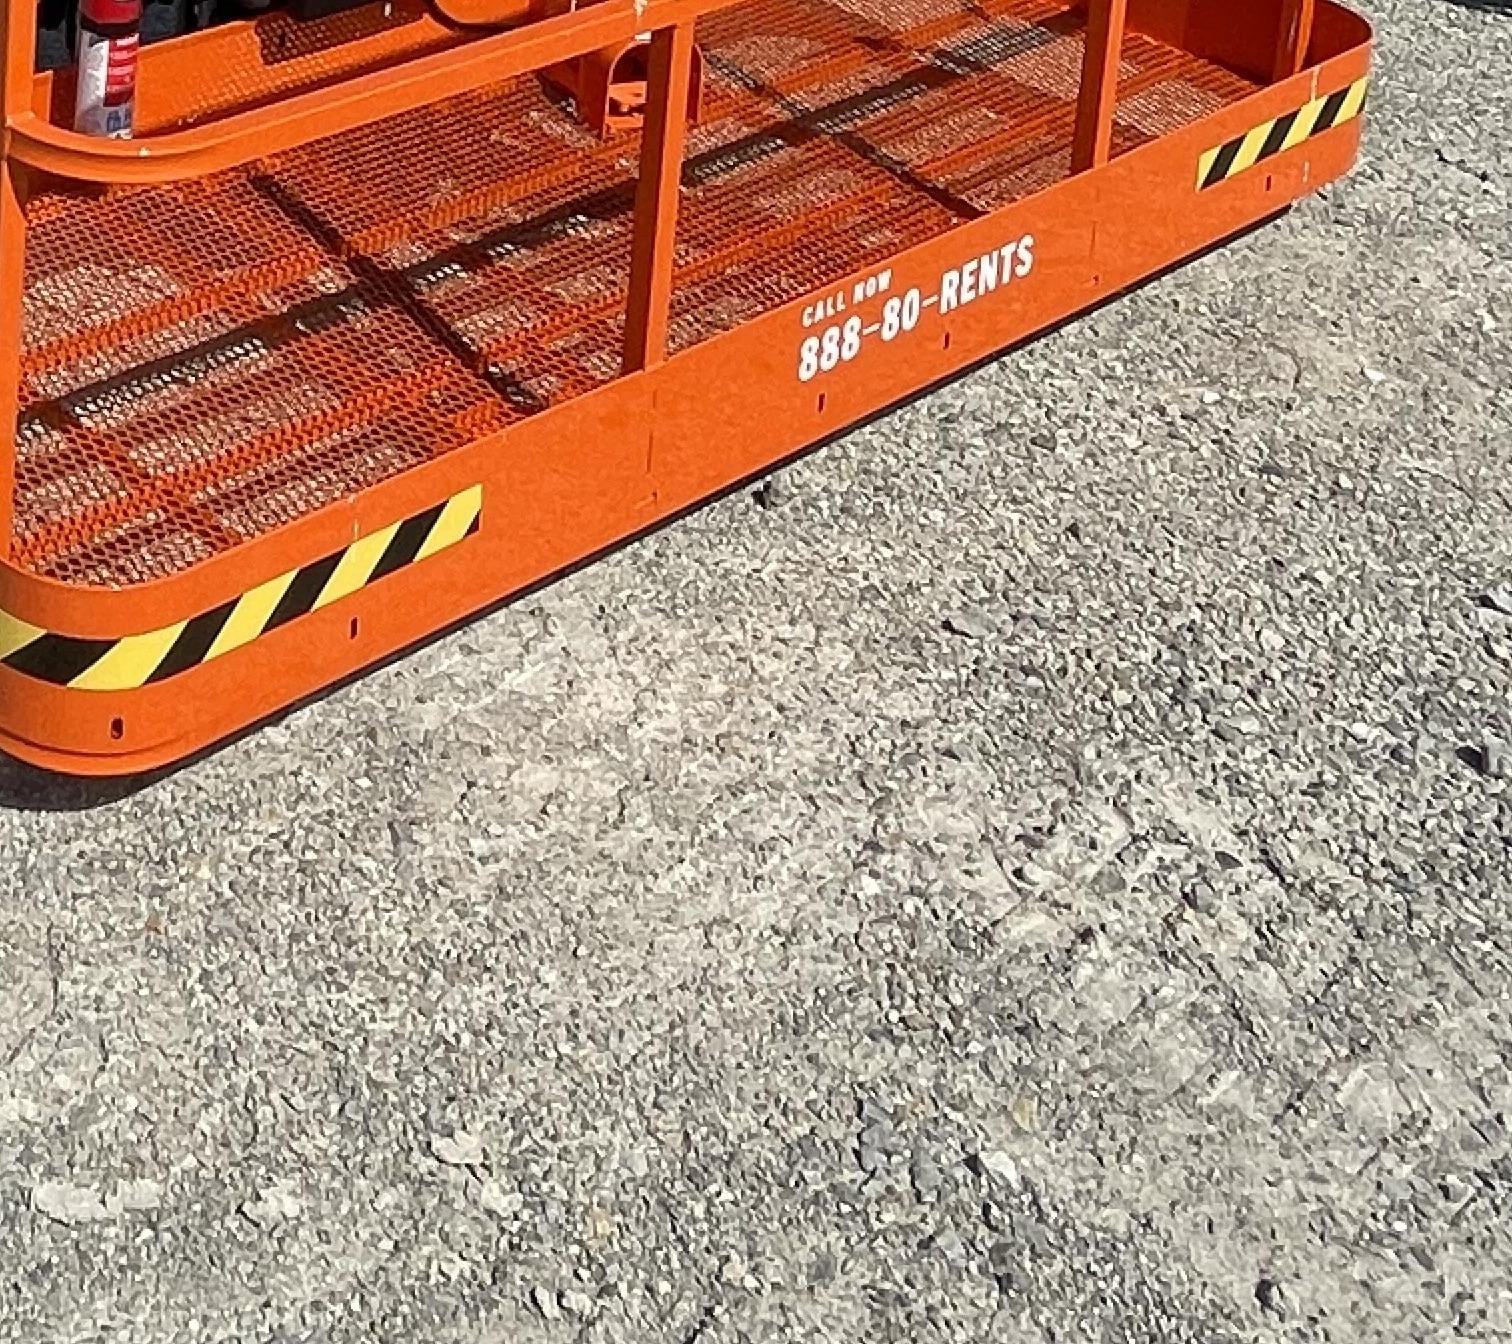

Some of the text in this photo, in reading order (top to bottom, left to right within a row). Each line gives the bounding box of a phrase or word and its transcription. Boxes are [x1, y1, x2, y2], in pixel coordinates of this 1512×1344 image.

[797, 234, 1034, 382] 888-80-RENTS
[802, 268, 892, 328] CALL NOW
